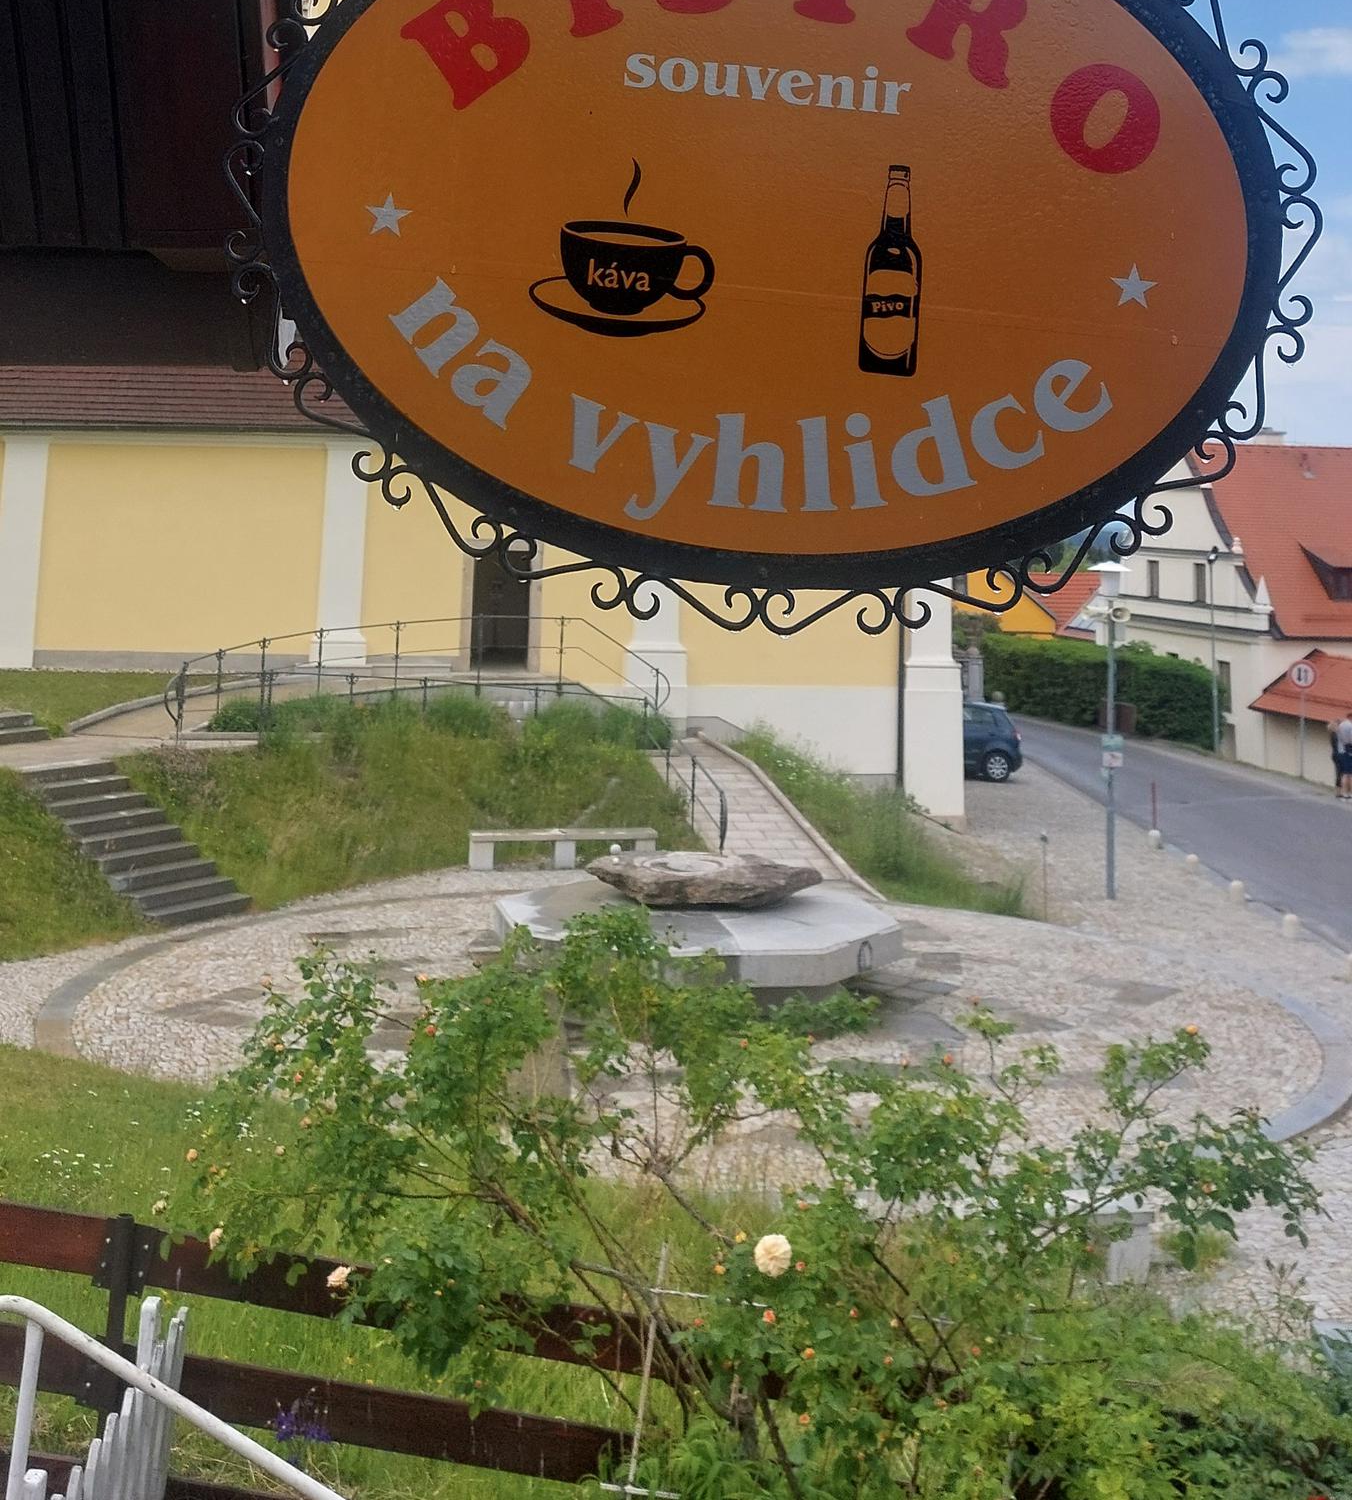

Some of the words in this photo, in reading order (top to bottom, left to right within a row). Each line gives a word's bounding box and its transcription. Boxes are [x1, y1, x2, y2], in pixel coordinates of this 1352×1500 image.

[623, 52, 912, 116] souvenir
[587, 258, 651, 292] káva
[871, 300, 905, 313] Pivo
[388, 275, 535, 430] na
[569, 357, 1114, 520] vyhlidce
